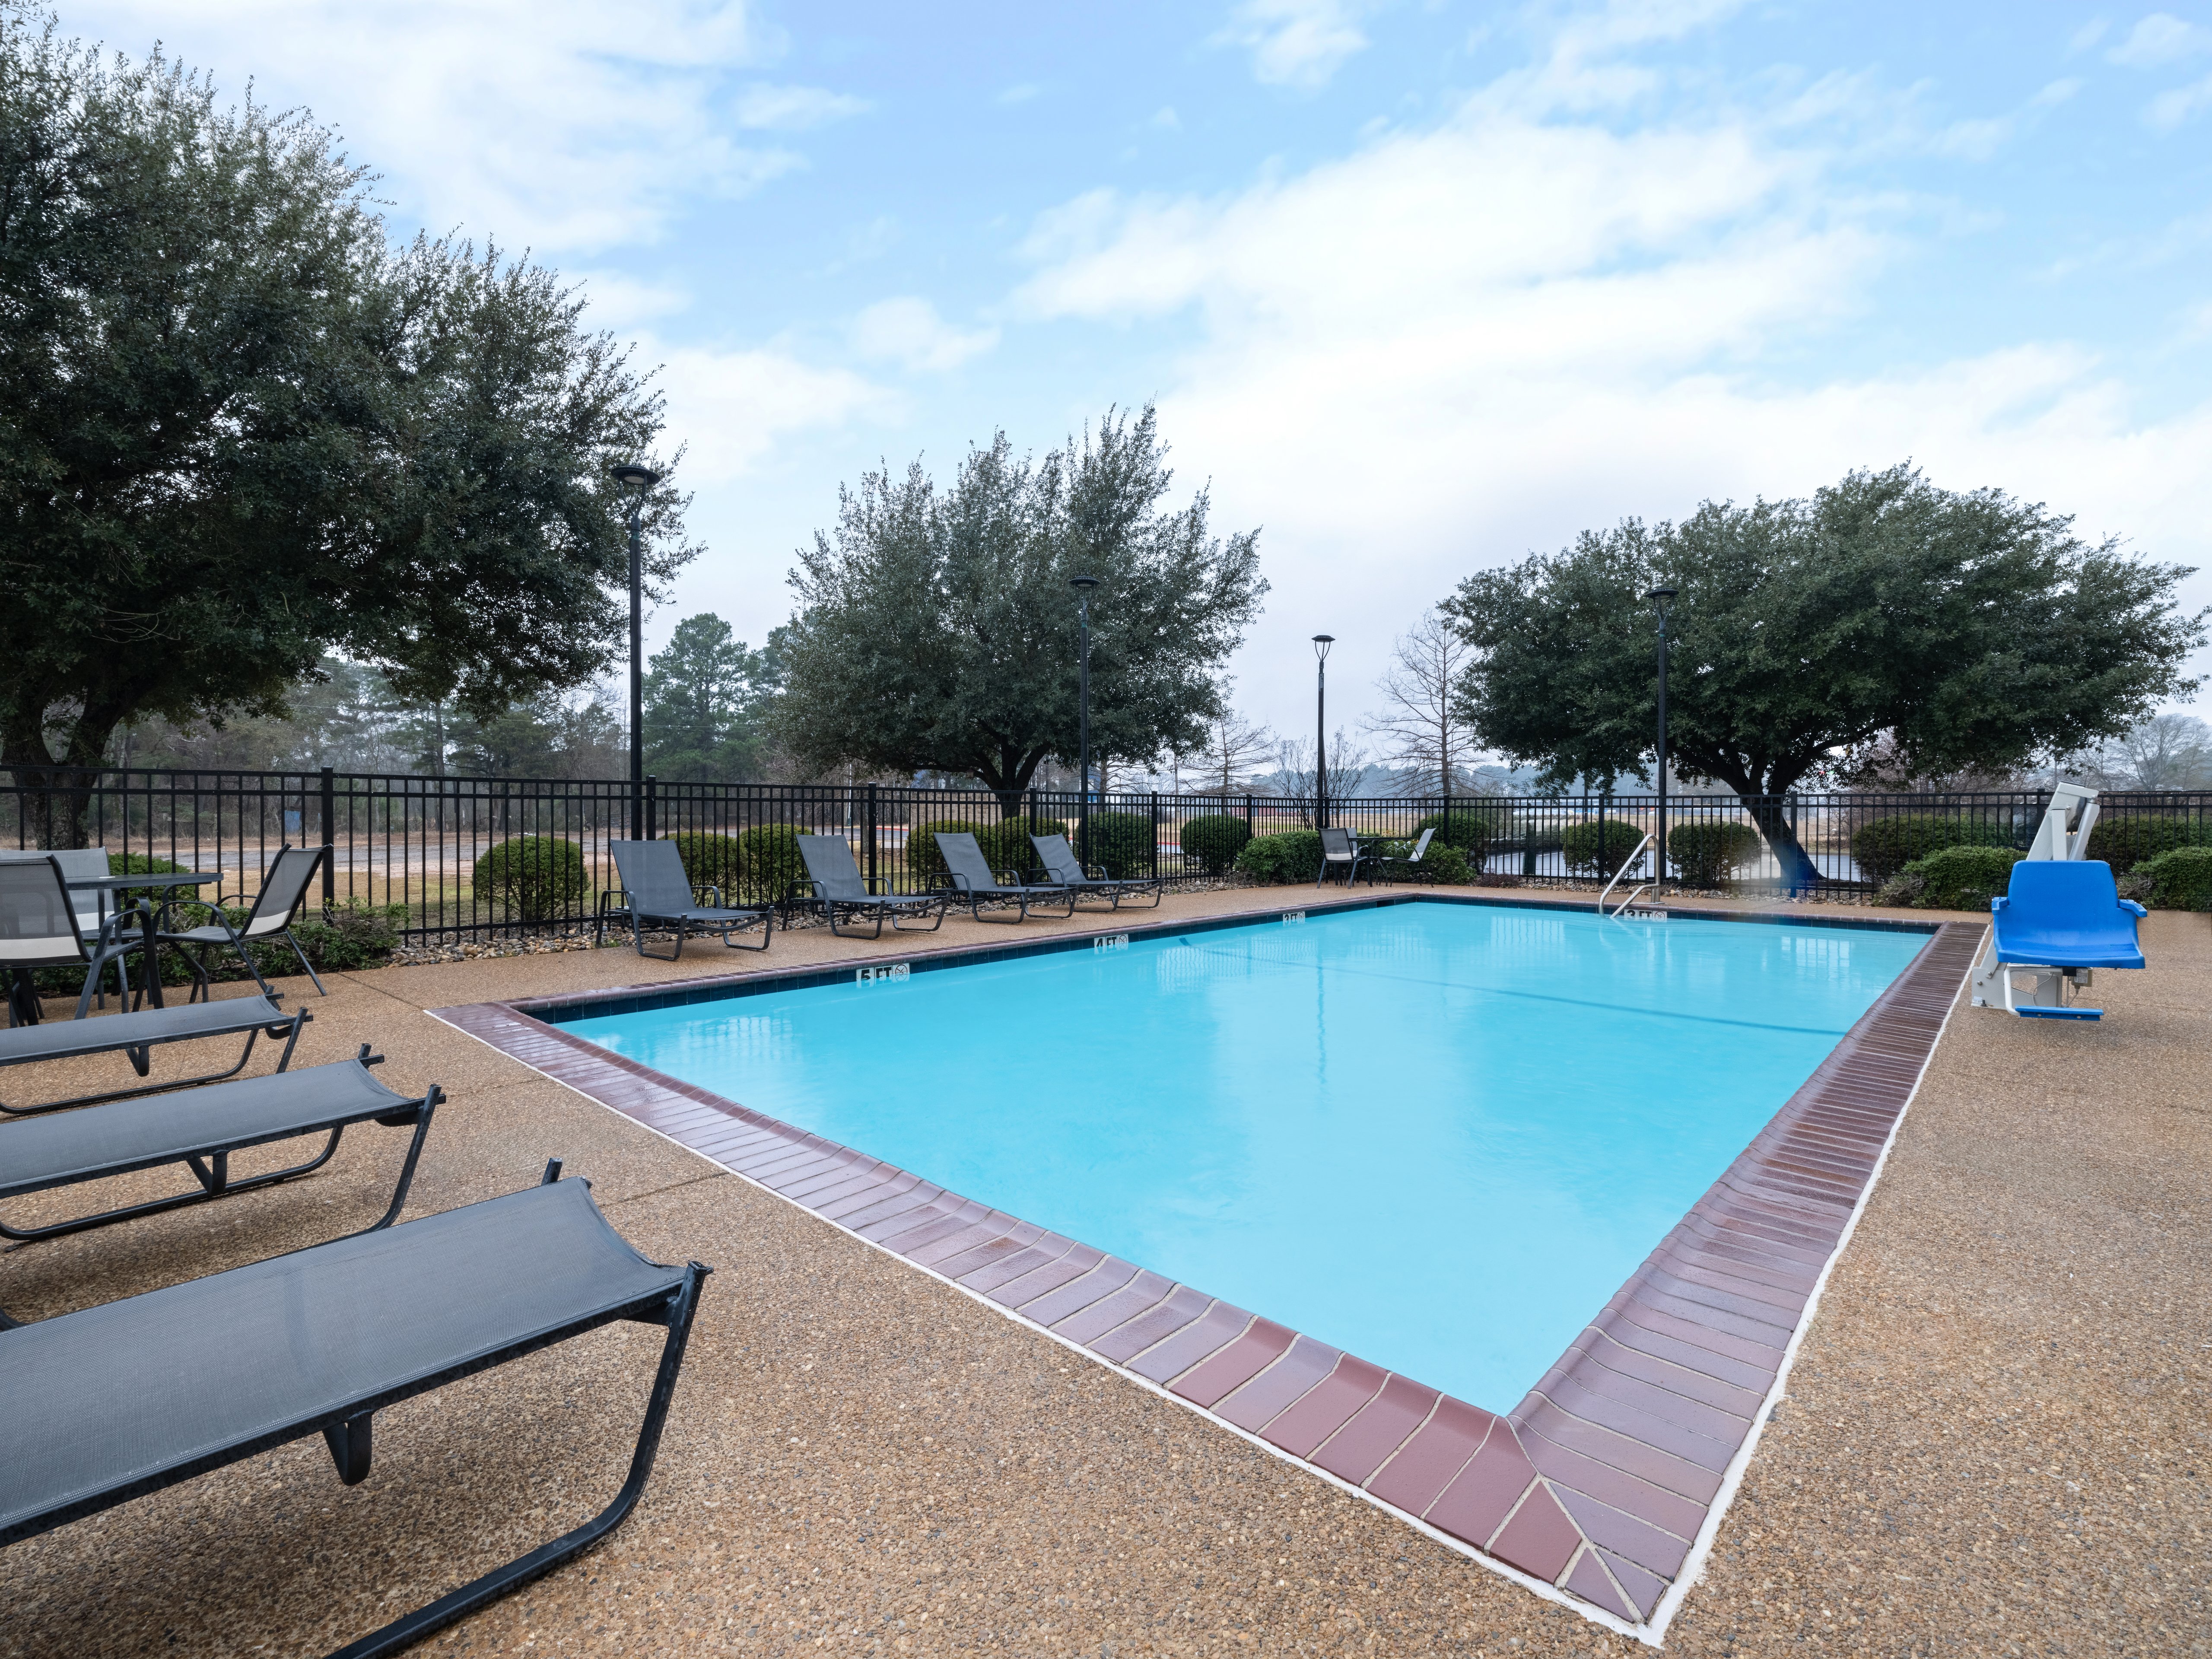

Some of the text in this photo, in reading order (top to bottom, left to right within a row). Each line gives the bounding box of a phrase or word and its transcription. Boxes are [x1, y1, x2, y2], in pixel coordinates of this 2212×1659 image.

[1096, 936, 1117, 947] 4 FT
[861, 966, 892, 980] 5 FT
